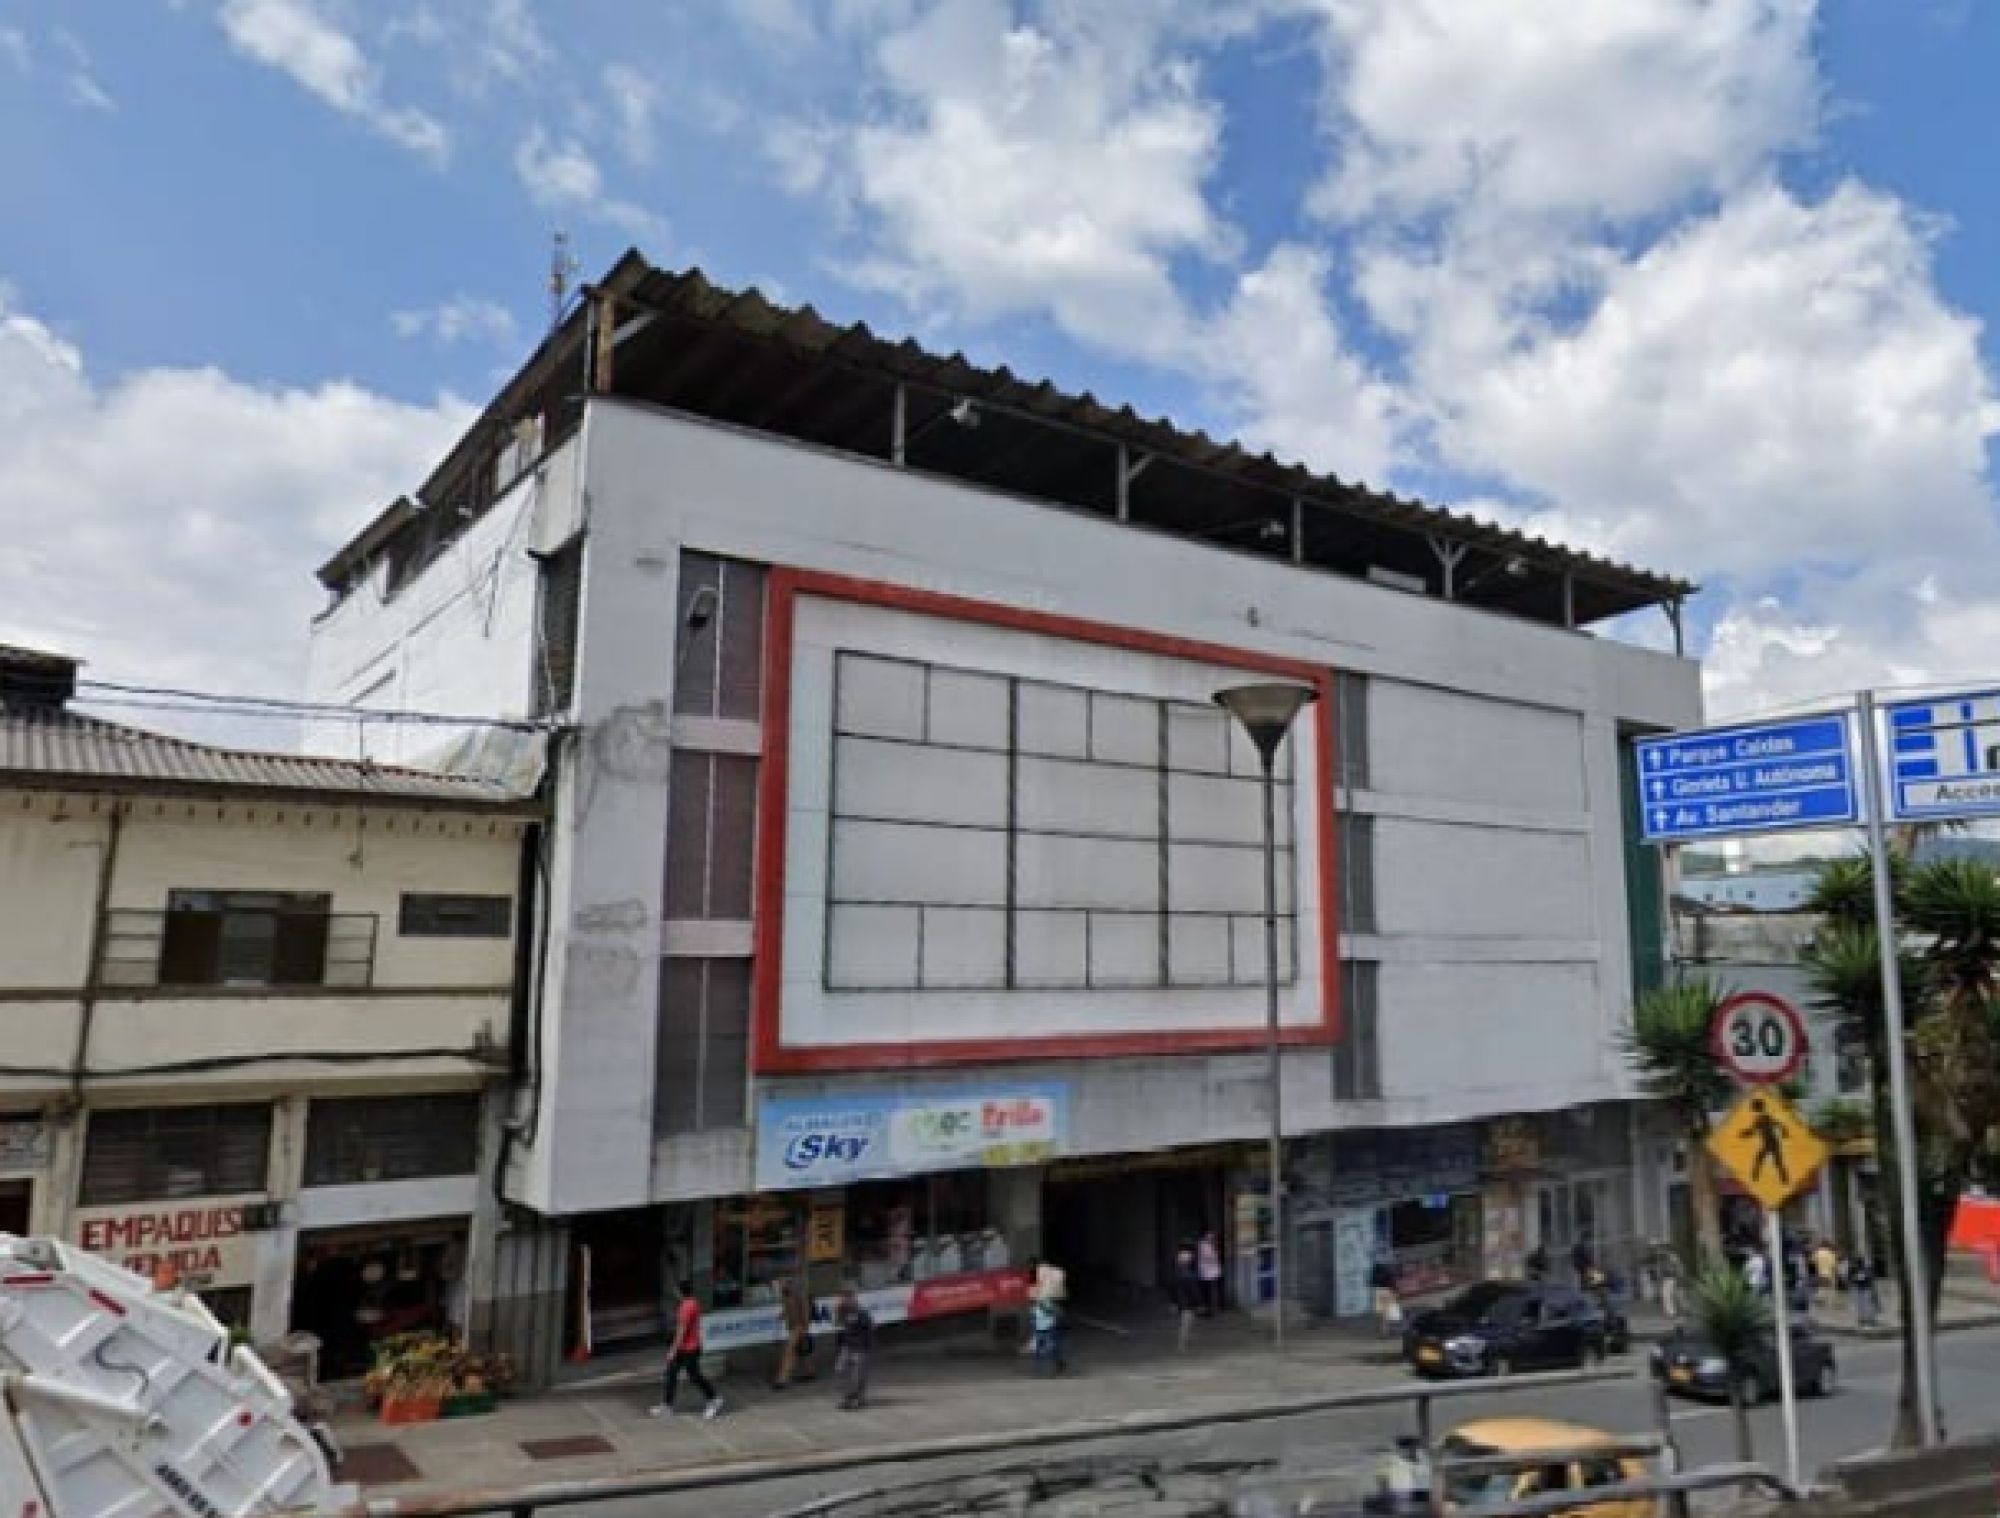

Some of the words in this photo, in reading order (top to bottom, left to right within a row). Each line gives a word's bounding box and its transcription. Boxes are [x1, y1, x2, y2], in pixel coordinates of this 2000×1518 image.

[1733, 1016, 1785, 1058] 30
[795, 1133, 870, 1166] Sky
[81, 1207, 244, 1252] EMPAQUES
